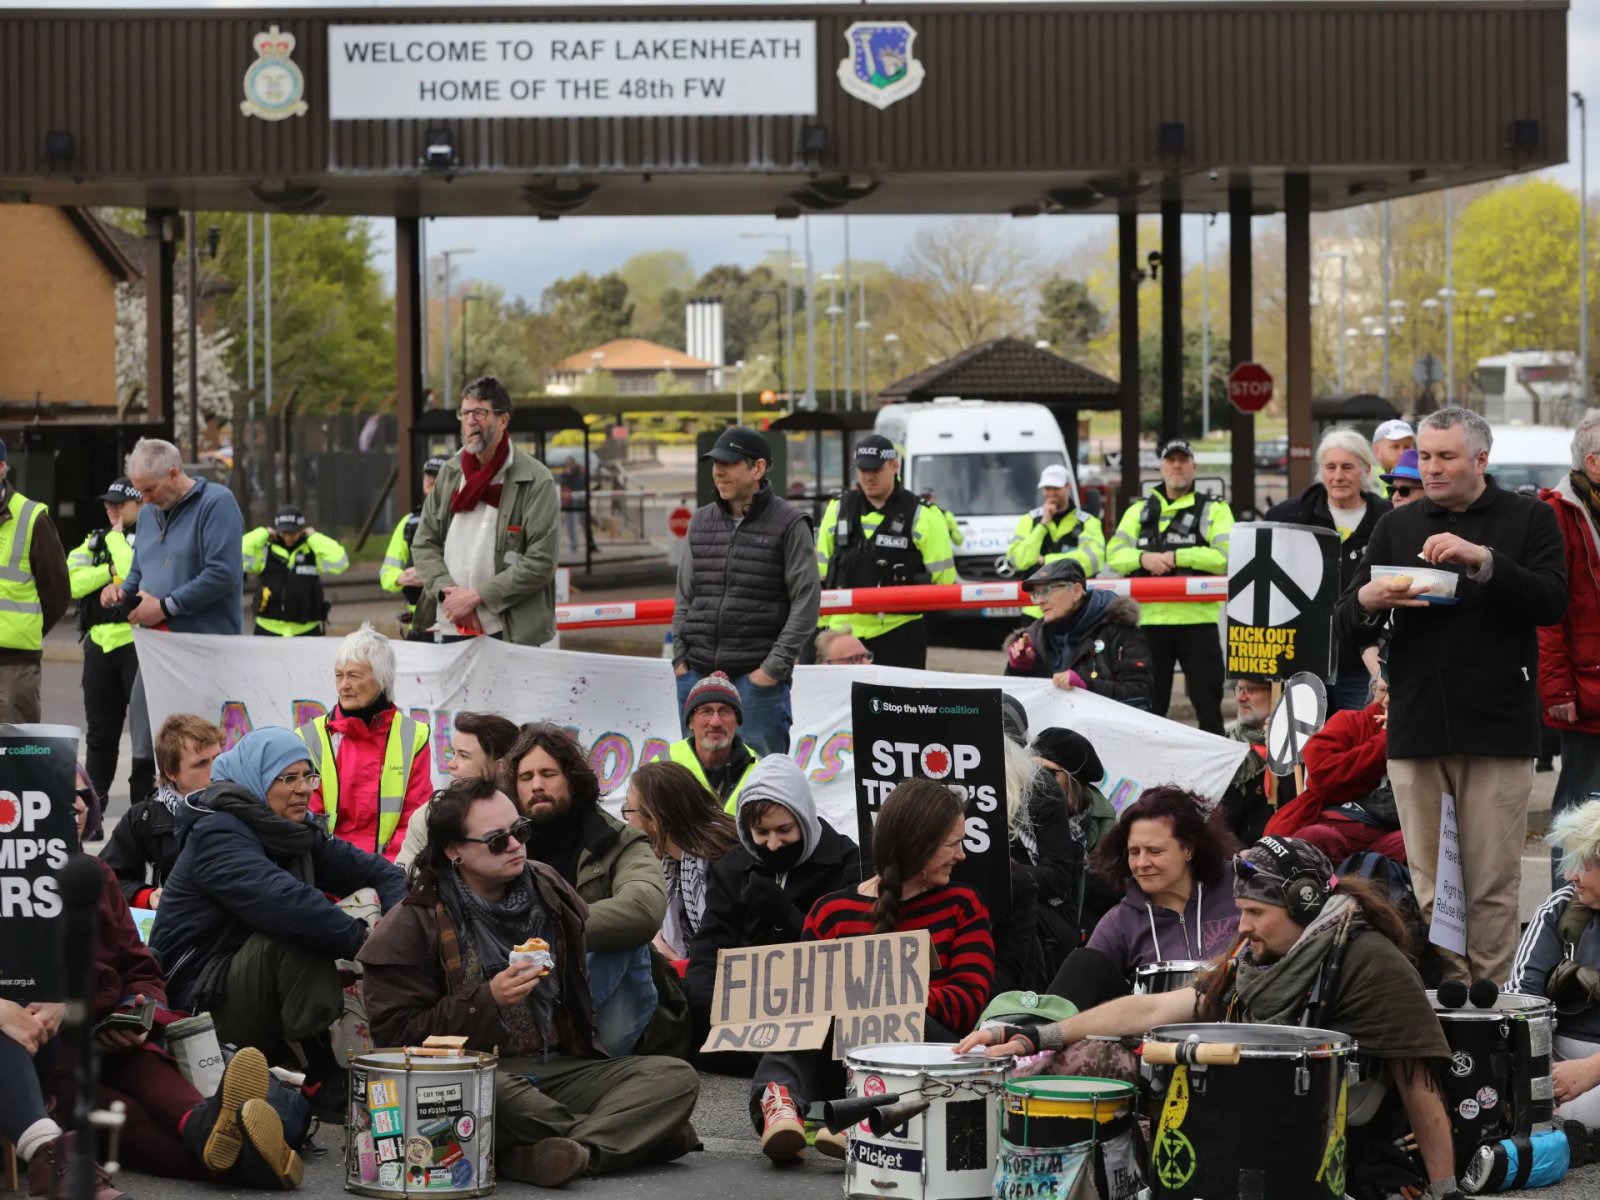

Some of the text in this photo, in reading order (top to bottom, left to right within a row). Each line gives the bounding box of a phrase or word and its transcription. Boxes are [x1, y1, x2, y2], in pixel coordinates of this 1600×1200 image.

[344, 38, 802, 63] WELCOME TO RAF LAKENHEATH
[418, 78, 726, 101] HOME OF THE 48th FW
[1231, 381, 1271, 396] STOP
[857, 447, 878, 455] POLICE
[877, 536, 906, 547] POLICE
[1229, 626, 1297, 644] KICK OUT
[1228, 642, 1295, 660] TRUMP'S
[1228, 657, 1278, 674] NUKES
[882, 702, 979, 715] Stop the War coalition
[8, 745, 51, 755] coalition
[872, 740, 981, 779] STOP
[1443, 880, 1457, 899] Right
[1436, 898, 1456, 918] Refuse
[721, 936, 924, 1021] FIGHT WAR
[712, 1012, 921, 1059] NOT WARS
[423, 1090, 434, 1098] CUT
[428, 1107, 446, 1115] FOSSIL
[447, 1105, 462, 1113] FUELS
[859, 1145, 903, 1168] Picket
